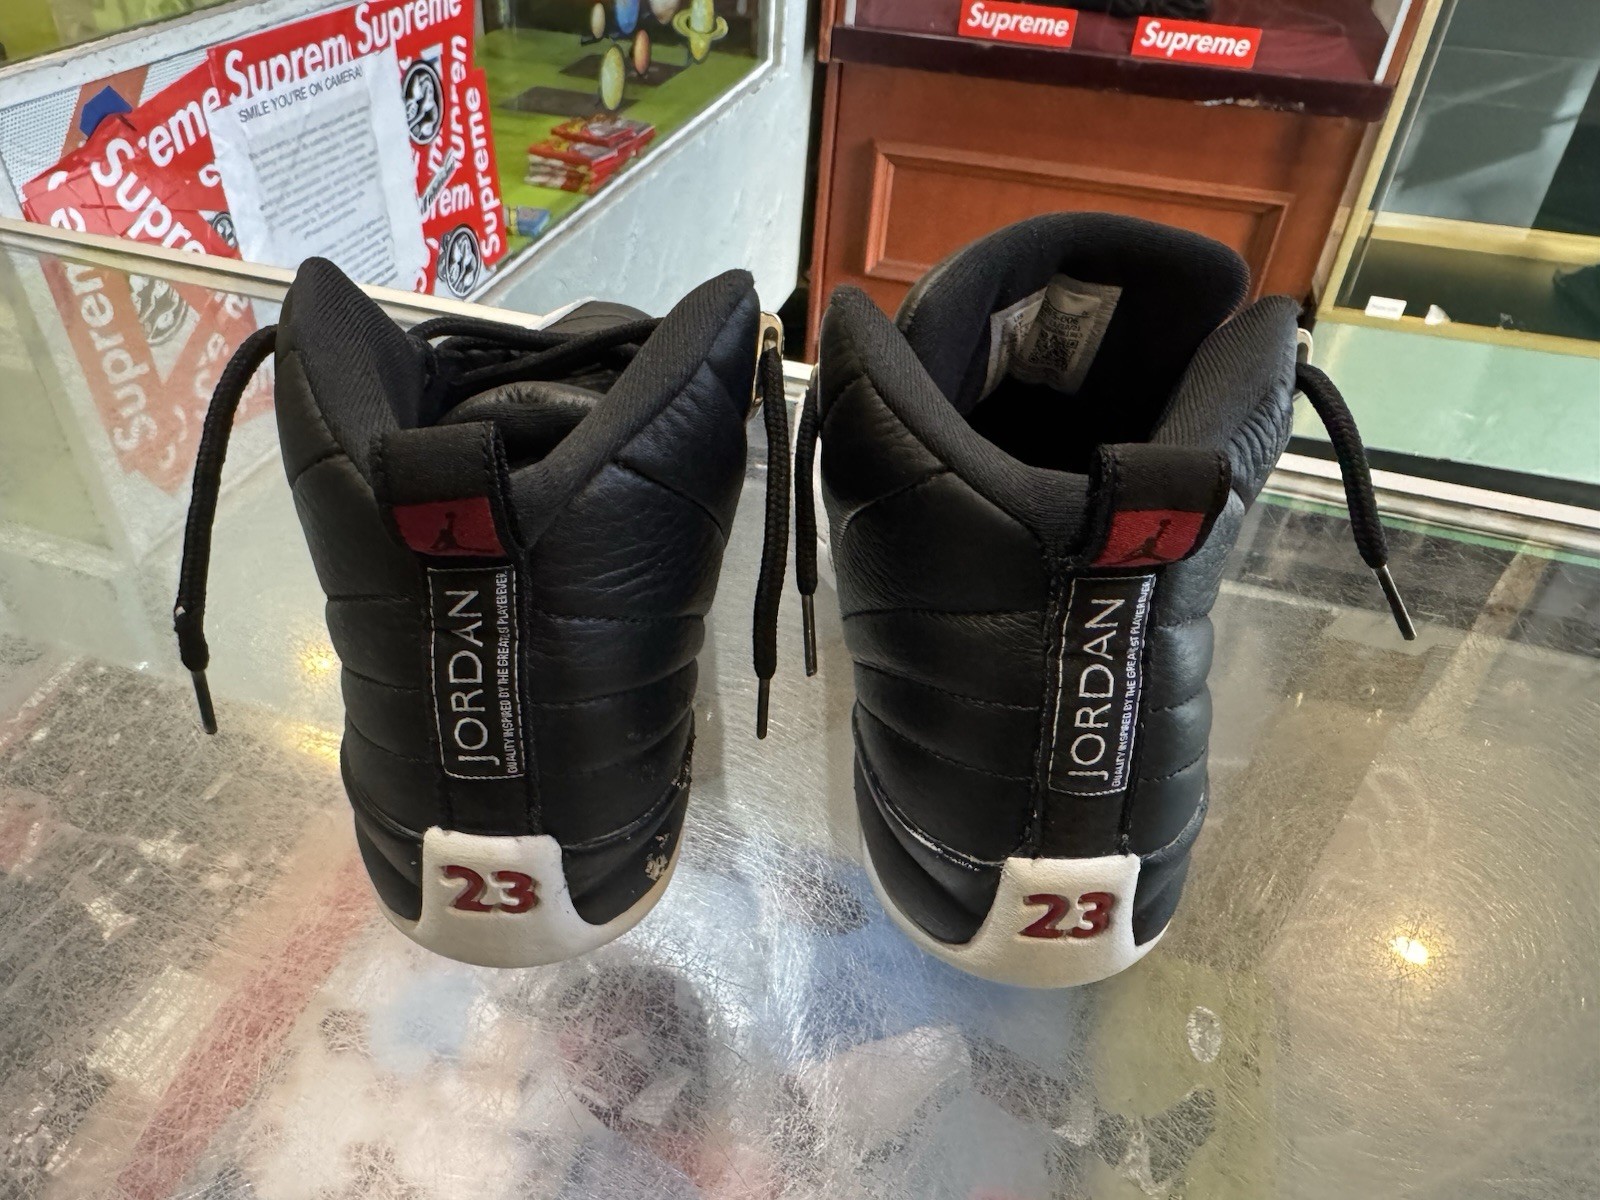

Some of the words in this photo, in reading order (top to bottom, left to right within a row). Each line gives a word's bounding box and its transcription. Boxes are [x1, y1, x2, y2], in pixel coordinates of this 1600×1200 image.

[967, 3, 1070, 37] Supreme
[1140, 21, 1252, 58] Supreme
[224, 34, 353, 103] Suprem
[238, 100, 270, 122] SMILE
[271, 86, 307, 110] YOU'RE
[309, 81, 324, 96] ON
[465, 87, 500, 258] Supreme
[496, 595, 509, 625] PLAYER
[1130, 603, 1146, 635] PLAYER
[445, 590, 500, 766] JORDAN
[497, 668, 509, 685] THE
[498, 686, 510, 698] BY
[1068, 599, 1125, 781] JORDAN
[1125, 680, 1137, 699] THE
[1123, 699, 1134, 711] BY
[1117, 712, 1132, 752] INSPIRED
[504, 738, 518, 774] QUALITY
[1111, 752, 1126, 787] QUALITY
[440, 865, 541, 914] 23
[1018, 892, 1118, 939] 23
